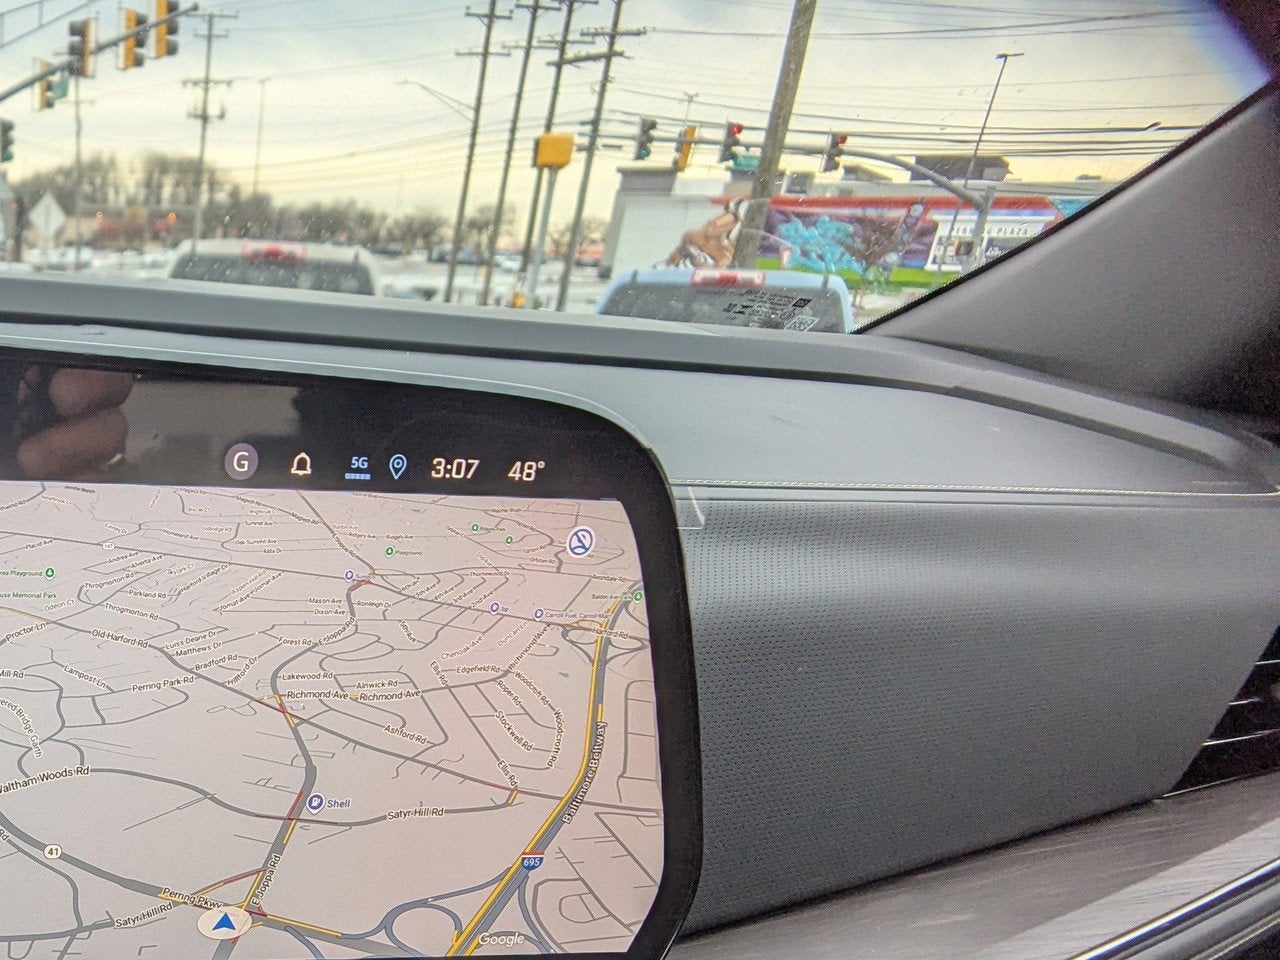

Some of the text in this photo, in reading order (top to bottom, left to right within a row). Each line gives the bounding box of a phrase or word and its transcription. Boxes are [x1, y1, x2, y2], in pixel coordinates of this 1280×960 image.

[234, 451, 248, 472] G
[351, 456, 368, 469] 5G
[431, 457, 480, 479] 3:07
[507, 461, 545, 481] 48°
[128, 589, 166, 600] Parkland Rd
[5, 621, 46, 642] Proctor Ln
[91, 629, 149, 648] Old Harford Rd
[175, 641, 222, 657] Matthews Dr
[279, 637, 299, 646] Forest
[195, 655, 238, 671] Bradford Rd
[456, 665, 500, 674] Edgefield Rd
[12, 670, 24, 678] Rd
[282, 672, 333, 680] Lakewood Rd
[132, 676, 194, 692] Perring Park Rd
[356, 680, 398, 689] Alnwick Rd
[287, 690, 329, 699] Richmond
[360, 690, 420, 702] Richmond Ave
[14, 706, 36, 736] Bridge
[30, 733, 43, 758] Garth
[384, 724, 427, 744] Ashford Rd
[38, 768, 73, 783] Woods
[76, 766, 90, 775] Rd
[327, 799, 350, 808] Shell
[387, 807, 444, 820] Satyr Hill Rd
[47, 847, 60, 856] 41
[523, 857, 540, 867] 695
[258, 869, 275, 898] Joppa
[270, 855, 281, 868] Rd
[162, 887, 195, 904] Perring
[115, 902, 173, 928] Satyr Hill Rd
[478, 932, 524, 946] Google
